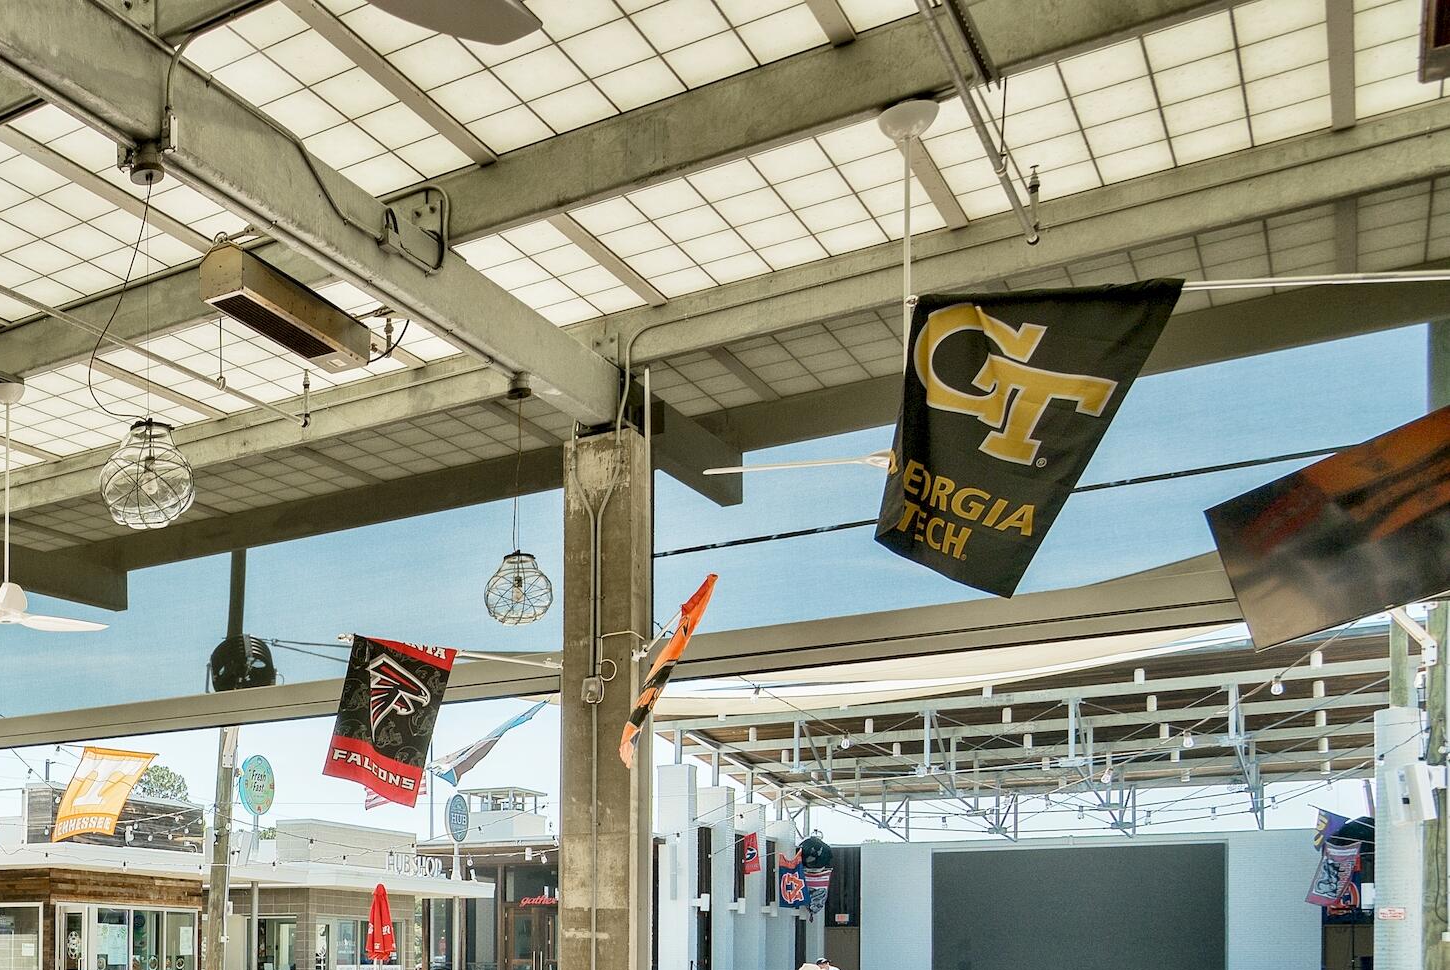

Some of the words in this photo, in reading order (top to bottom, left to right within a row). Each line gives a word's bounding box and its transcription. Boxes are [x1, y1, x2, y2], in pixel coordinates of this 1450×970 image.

[896, 500, 973, 559] TECH
[332, 748, 415, 791] FALCONS
[451, 813, 467, 824] HUB
[386, 854, 411, 874] HUB
[412, 855, 443, 877] SHOP
